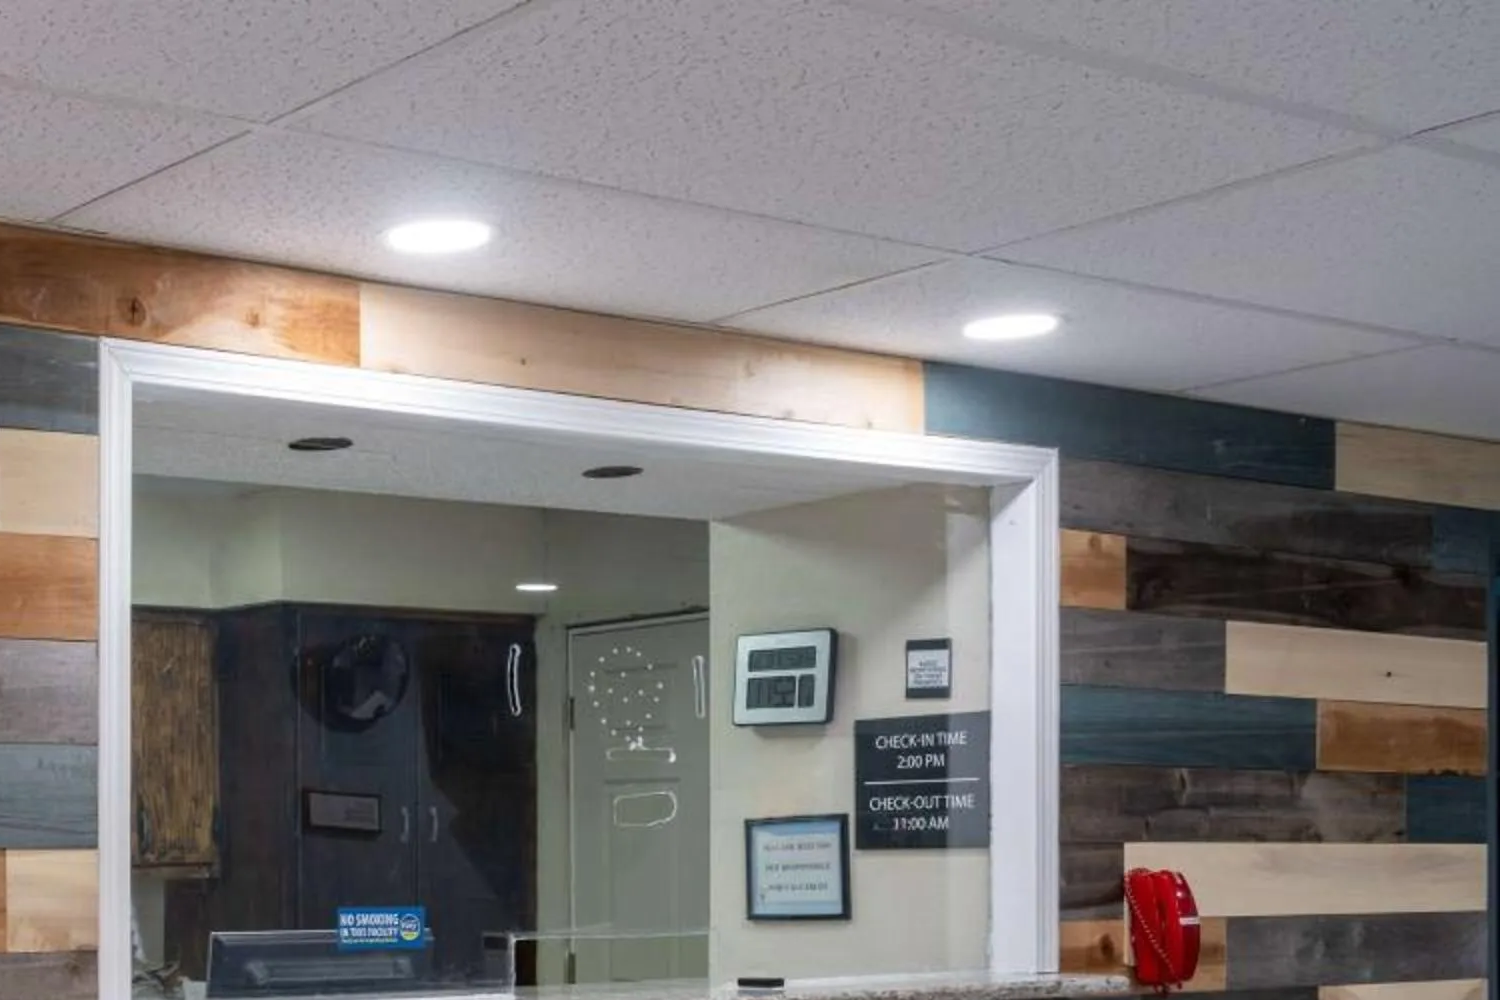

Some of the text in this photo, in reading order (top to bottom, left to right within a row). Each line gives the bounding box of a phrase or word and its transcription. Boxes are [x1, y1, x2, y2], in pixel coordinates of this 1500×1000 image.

[875, 730, 968, 749] CHECK-IN TIME
[897, 753, 945, 769] 2:00 PM
[869, 793, 977, 811] CHECK-OUT TIME
[893, 815, 950, 831] 11:00 AM
[340, 912, 399, 927] NO SMOKING
